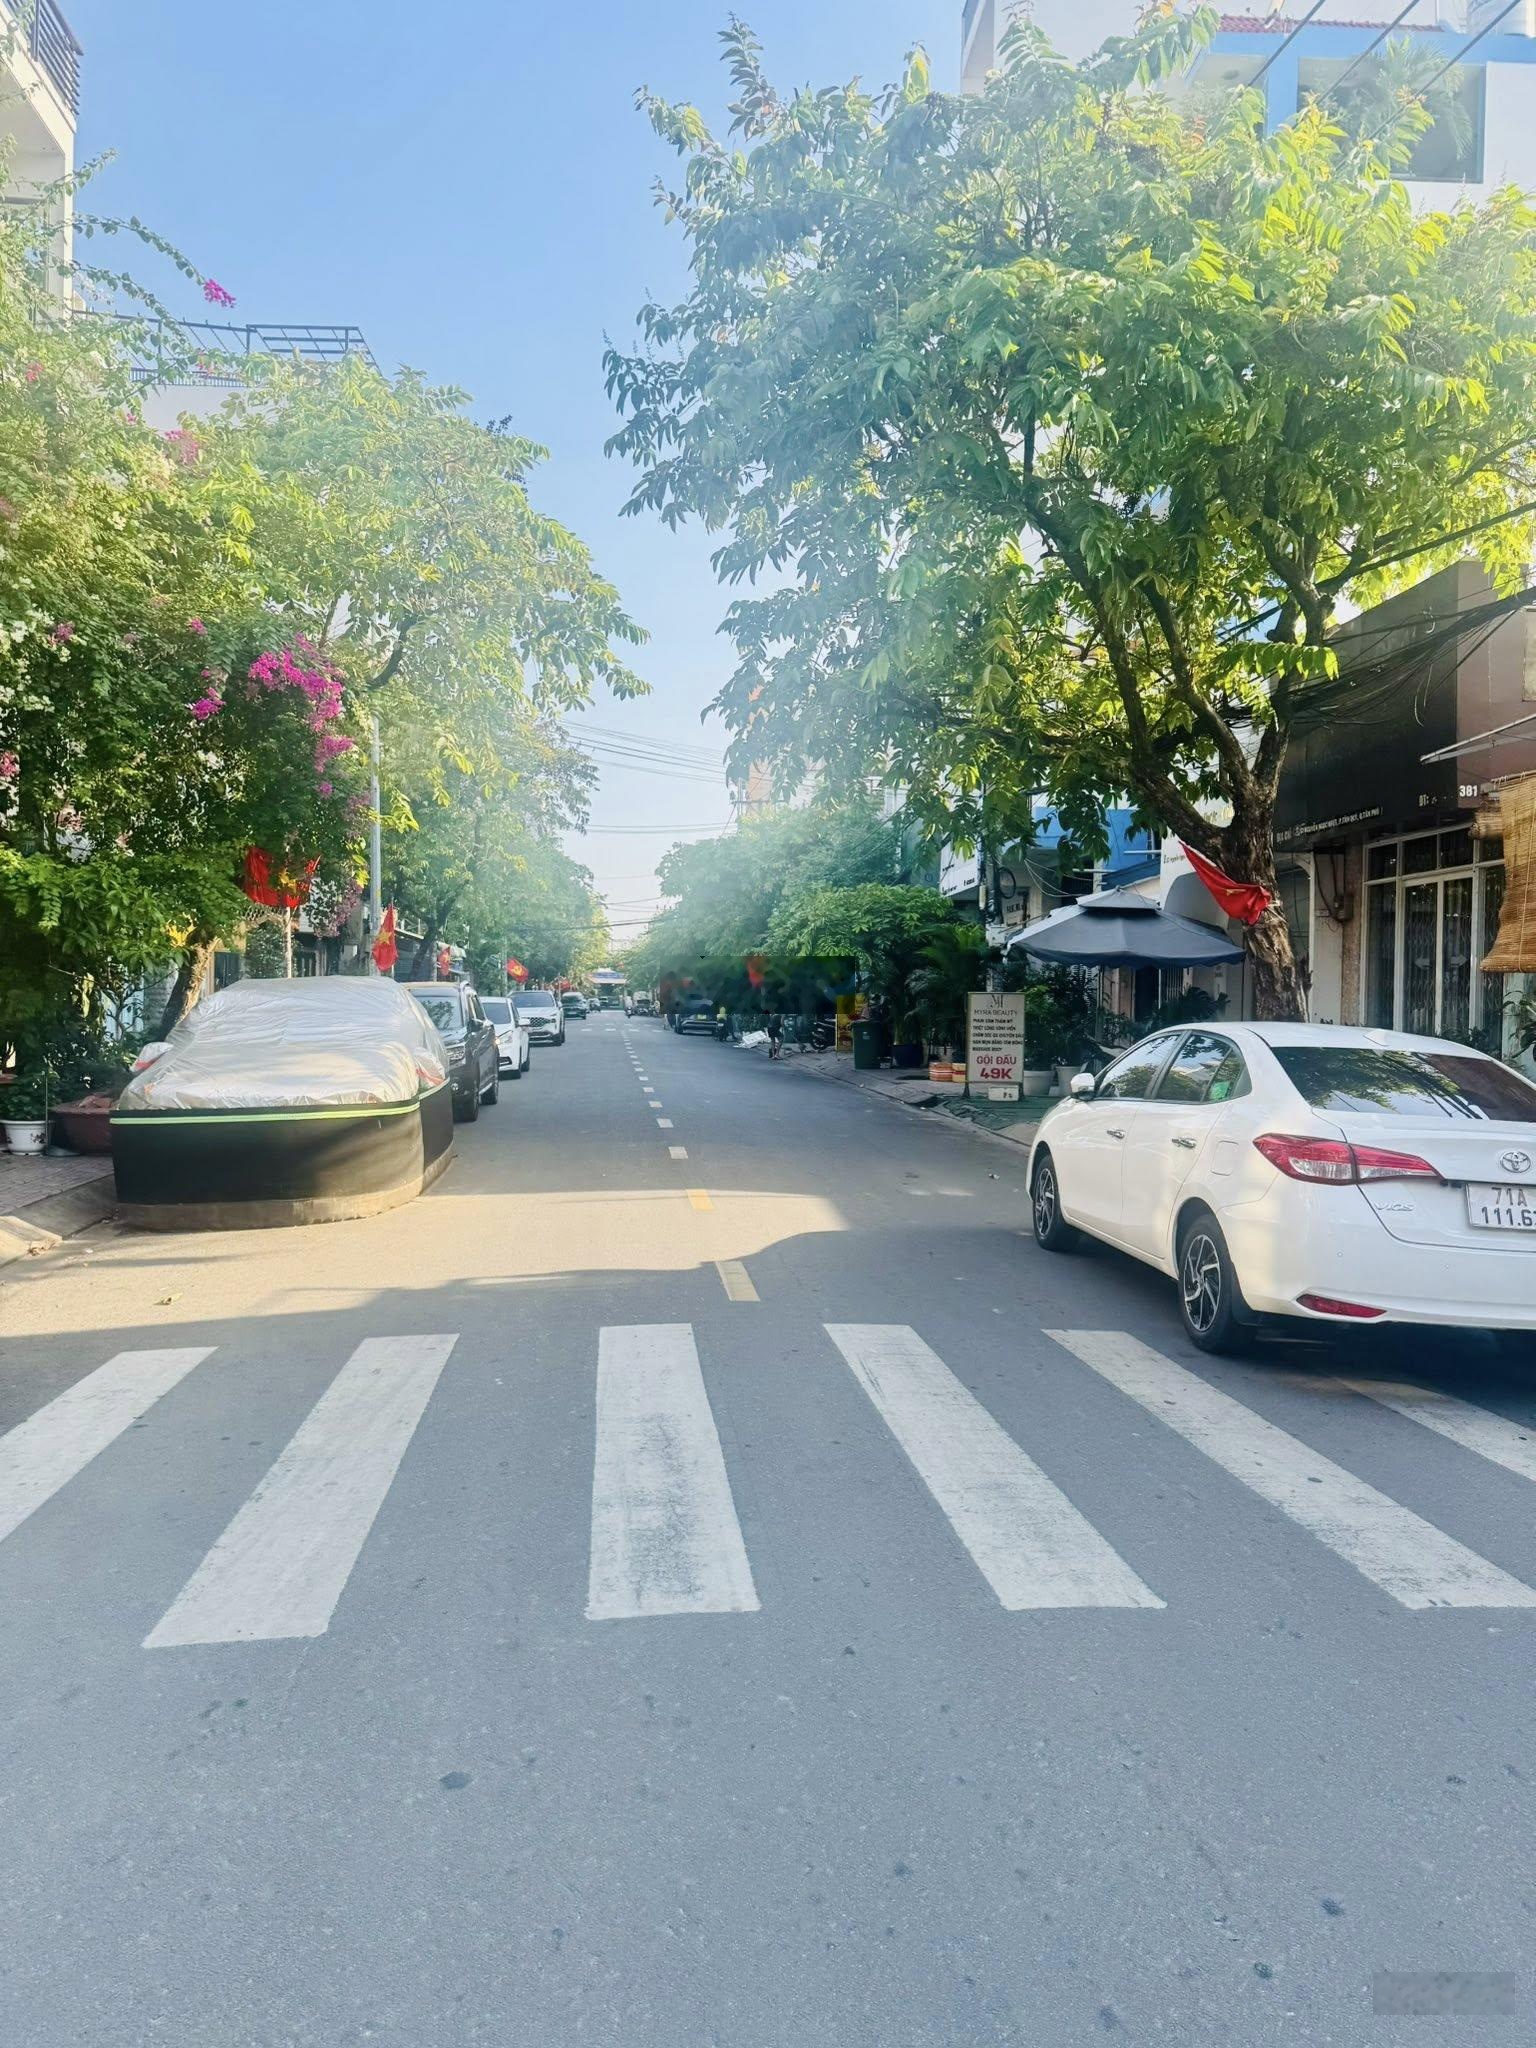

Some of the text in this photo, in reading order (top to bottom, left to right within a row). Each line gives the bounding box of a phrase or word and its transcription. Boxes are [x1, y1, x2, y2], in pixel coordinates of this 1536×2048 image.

[1459, 785, 1478, 797] 381
[980, 1067, 1012, 1080] 49K
[1491, 1186, 1527, 1207] 71A
[1481, 1206, 1536, 1227] 111.6
